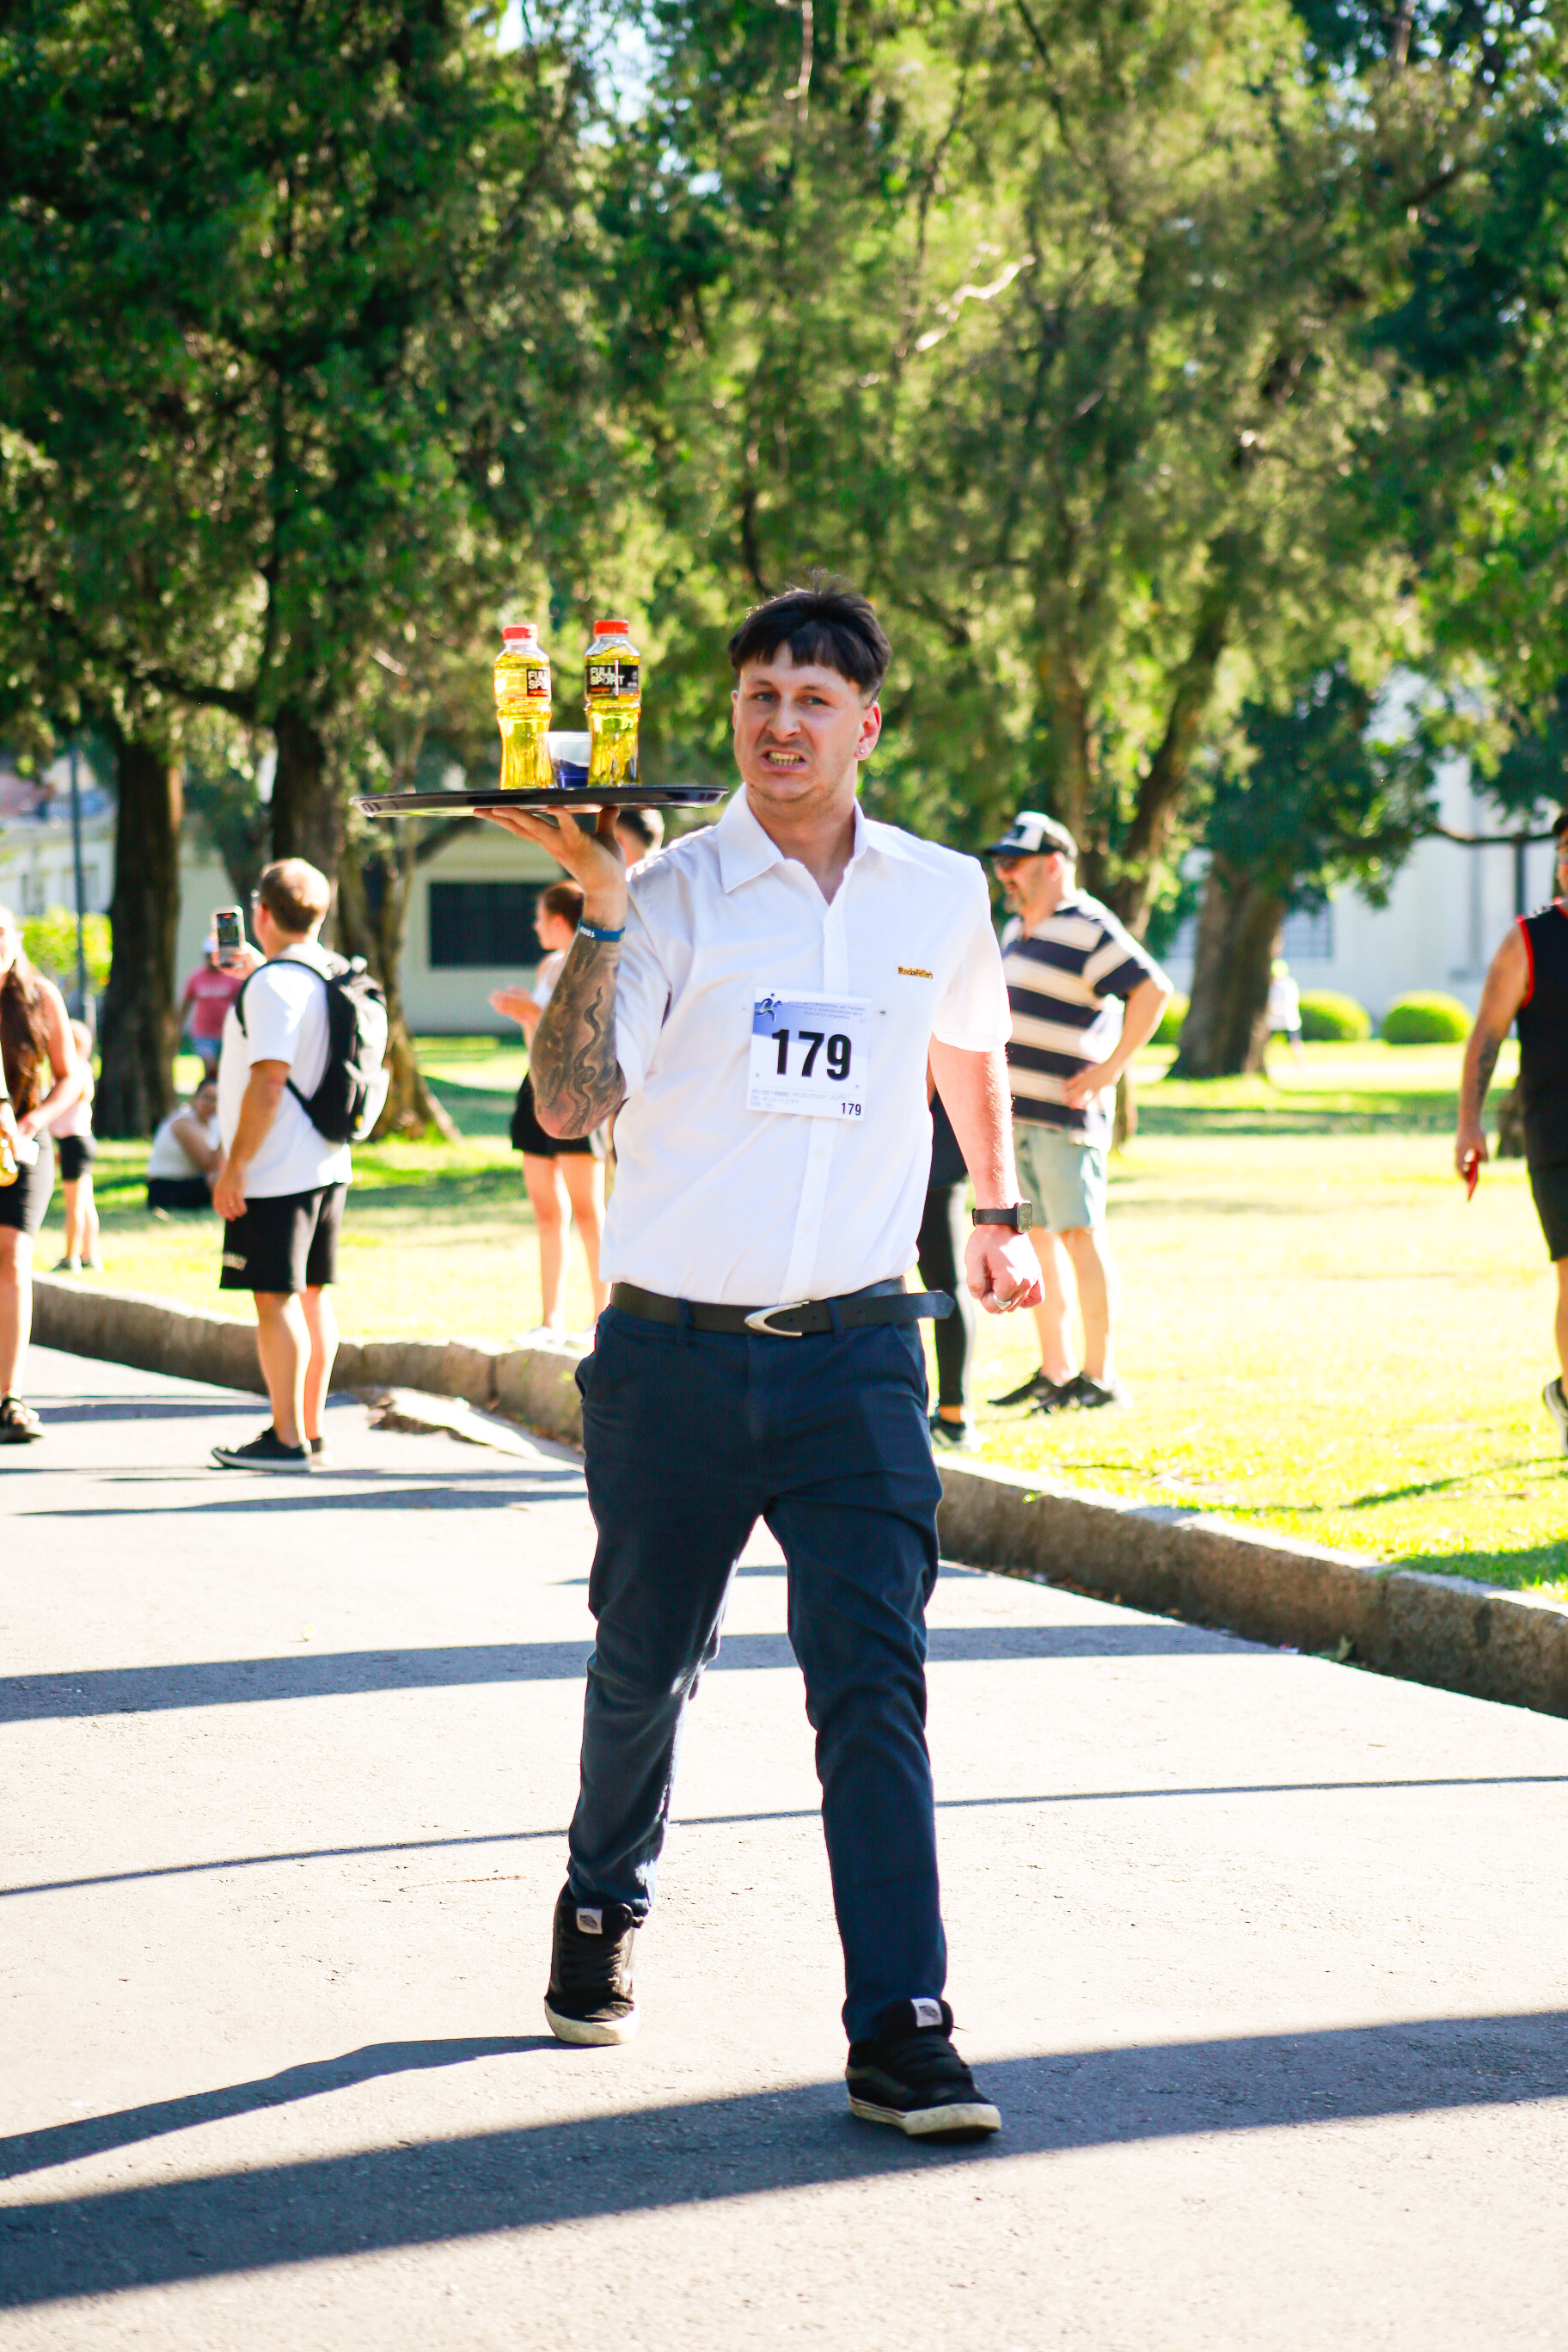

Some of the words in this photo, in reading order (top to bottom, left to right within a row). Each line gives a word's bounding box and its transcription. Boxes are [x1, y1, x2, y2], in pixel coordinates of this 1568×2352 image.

[591, 666, 615, 677] FULL
[591, 675, 625, 686] SPORT
[772, 1029, 852, 1081] 179
[842, 1102, 861, 1116] 179
